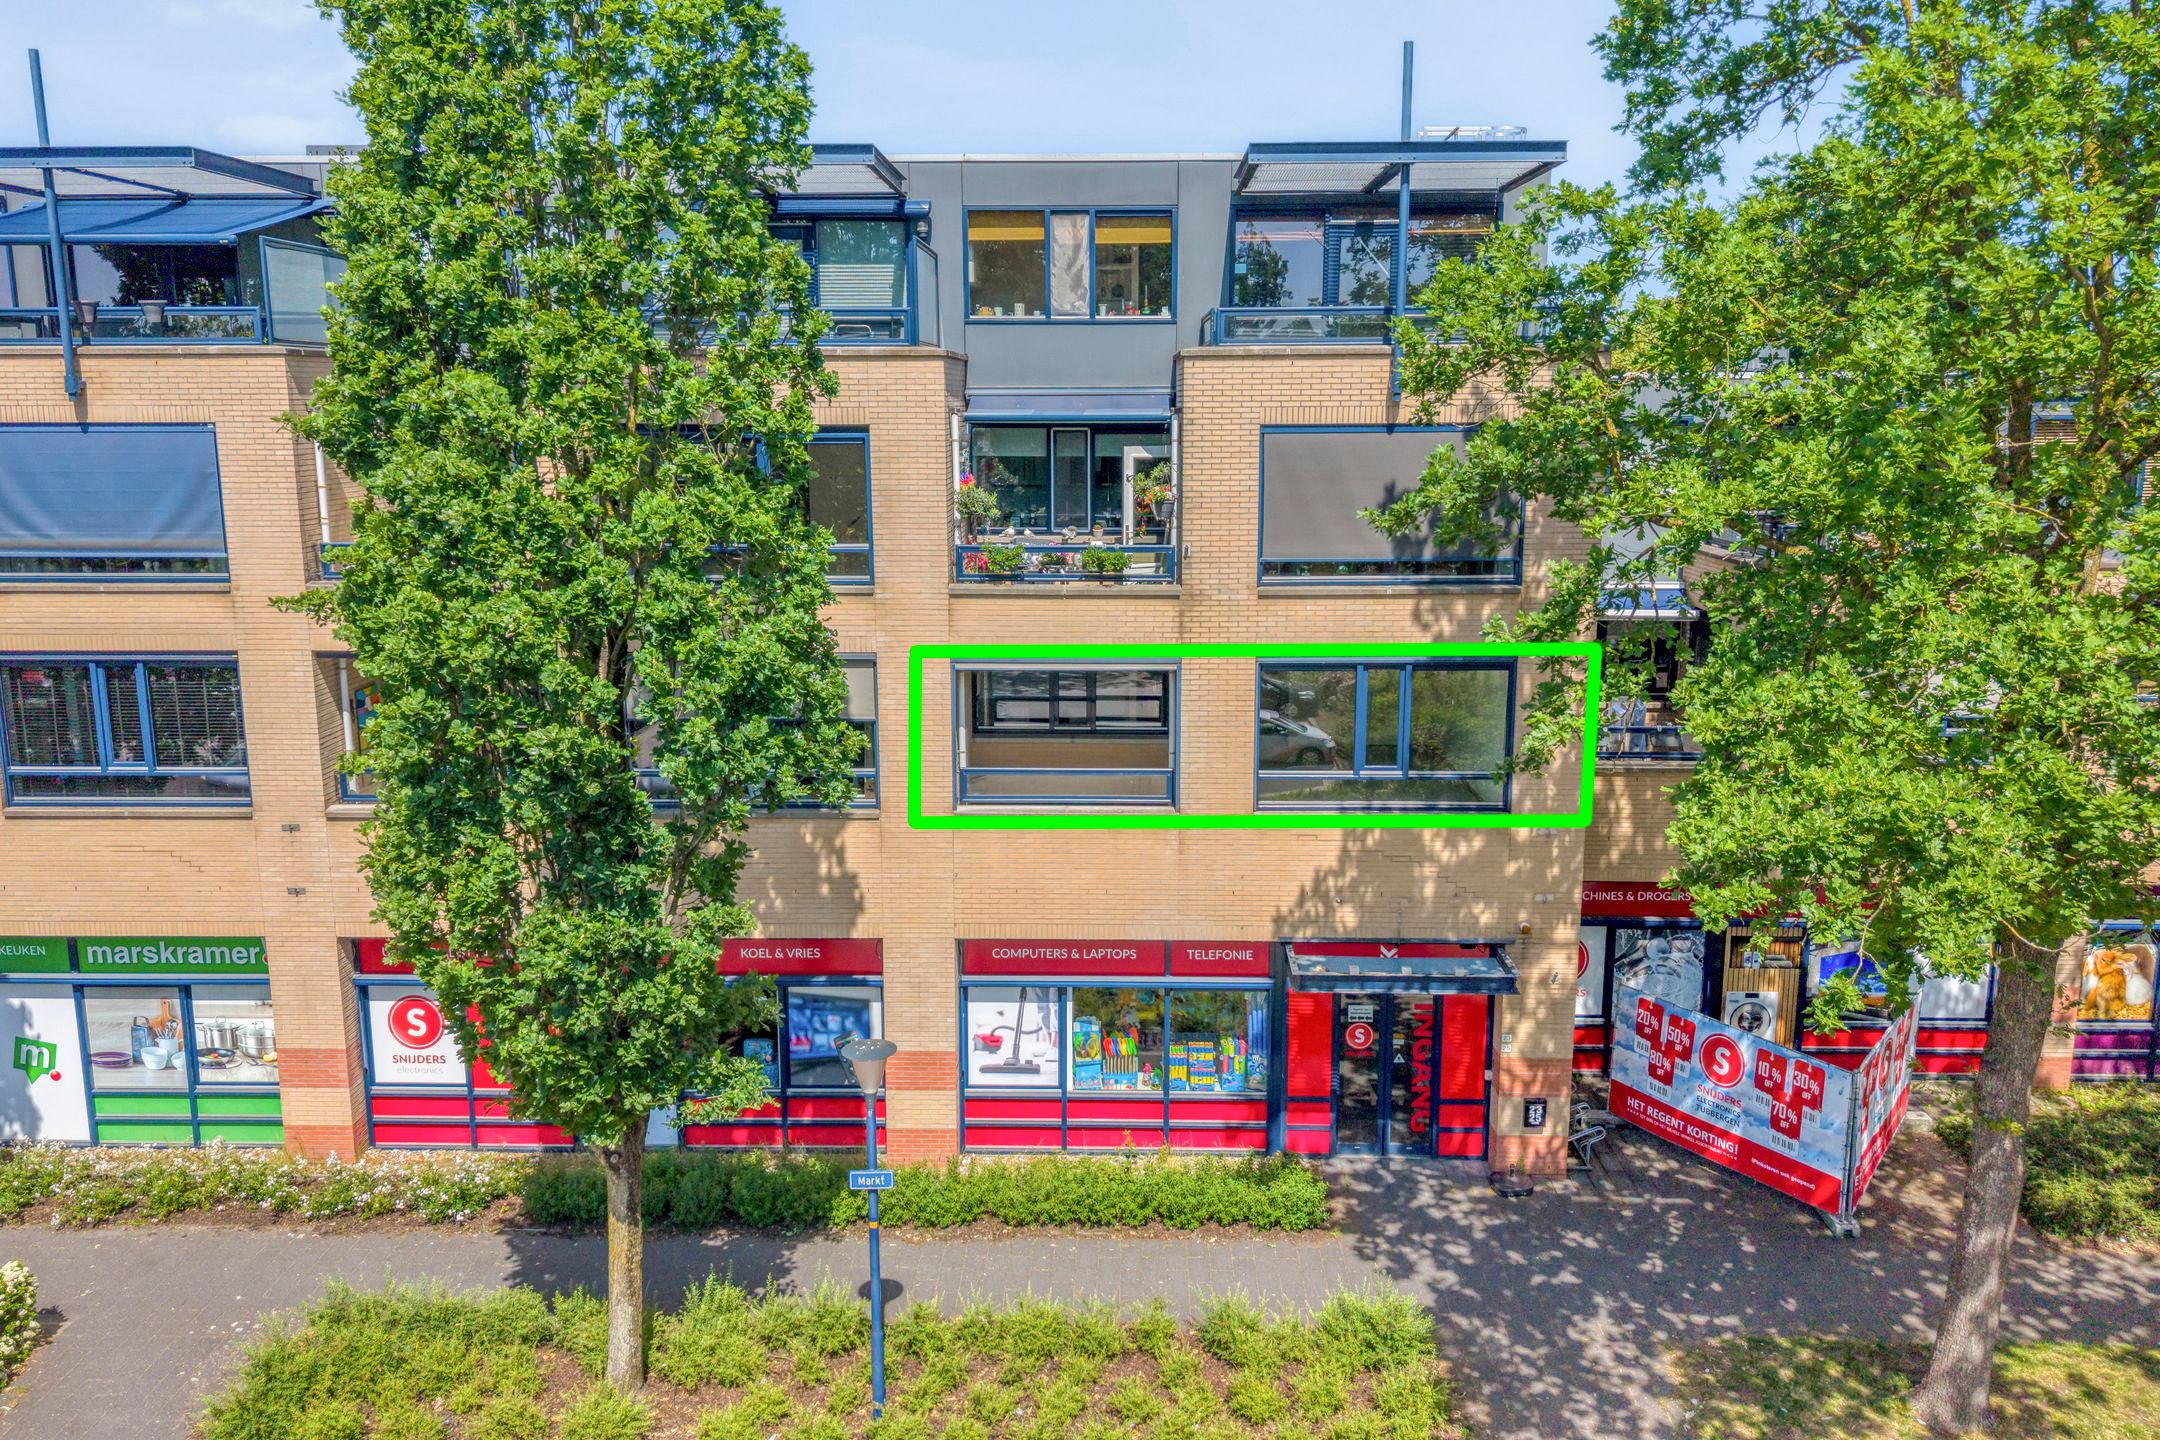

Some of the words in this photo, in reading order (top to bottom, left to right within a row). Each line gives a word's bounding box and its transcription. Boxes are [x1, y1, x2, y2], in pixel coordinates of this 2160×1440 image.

[1626, 892, 1635, 901] &
[87, 942, 260, 965] marskramer
[740, 948, 772, 958] KOEL
[775, 948, 784, 958] &
[786, 948, 821, 958] VRIES
[992, 948, 1068, 959] COMPUTERS
[1071, 948, 1080, 959] &
[1083, 949, 1137, 960] LAPTOPS
[1187, 949, 1253, 961] TELEFONIE
[406, 1008, 426, 1037] S
[1638, 1009, 1659, 1030] 20%
[1354, 1028, 1365, 1043] S
[1644, 1026, 1652, 1035] OFF
[1668, 1026, 1690, 1048] 50%
[20, 1043, 50, 1069] m
[392, 1055, 446, 1064] SNIJDERS
[1649, 1049, 1671, 1072] 80%
[1713, 1047, 1730, 1076] S
[397, 1066, 444, 1074] electronics
[1410, 1004, 1434, 1133] INGANG
[1764, 1079, 1774, 1089] OFF
[1794, 1071, 1819, 1095] 30%
[1697, 1084, 1741, 1108] SNIJDERS
[1802, 1091, 1812, 1101] OFF
[1529, 1105, 1542, 1114] 23
[1696, 1095, 1740, 1118] ELECTRONICS
[1696, 1104, 1740, 1127] TUBBERGEN
[1772, 1100, 1797, 1125] 70%
[1528, 1114, 1542, 1122] 25
[1627, 1096, 1645, 1112] HET
[1647, 1106, 1686, 1131] REGENT
[1687, 1124, 1738, 1155] KORTING!
[1780, 1120, 1790, 1129] OFF
[858, 1175, 885, 1185] Markt
